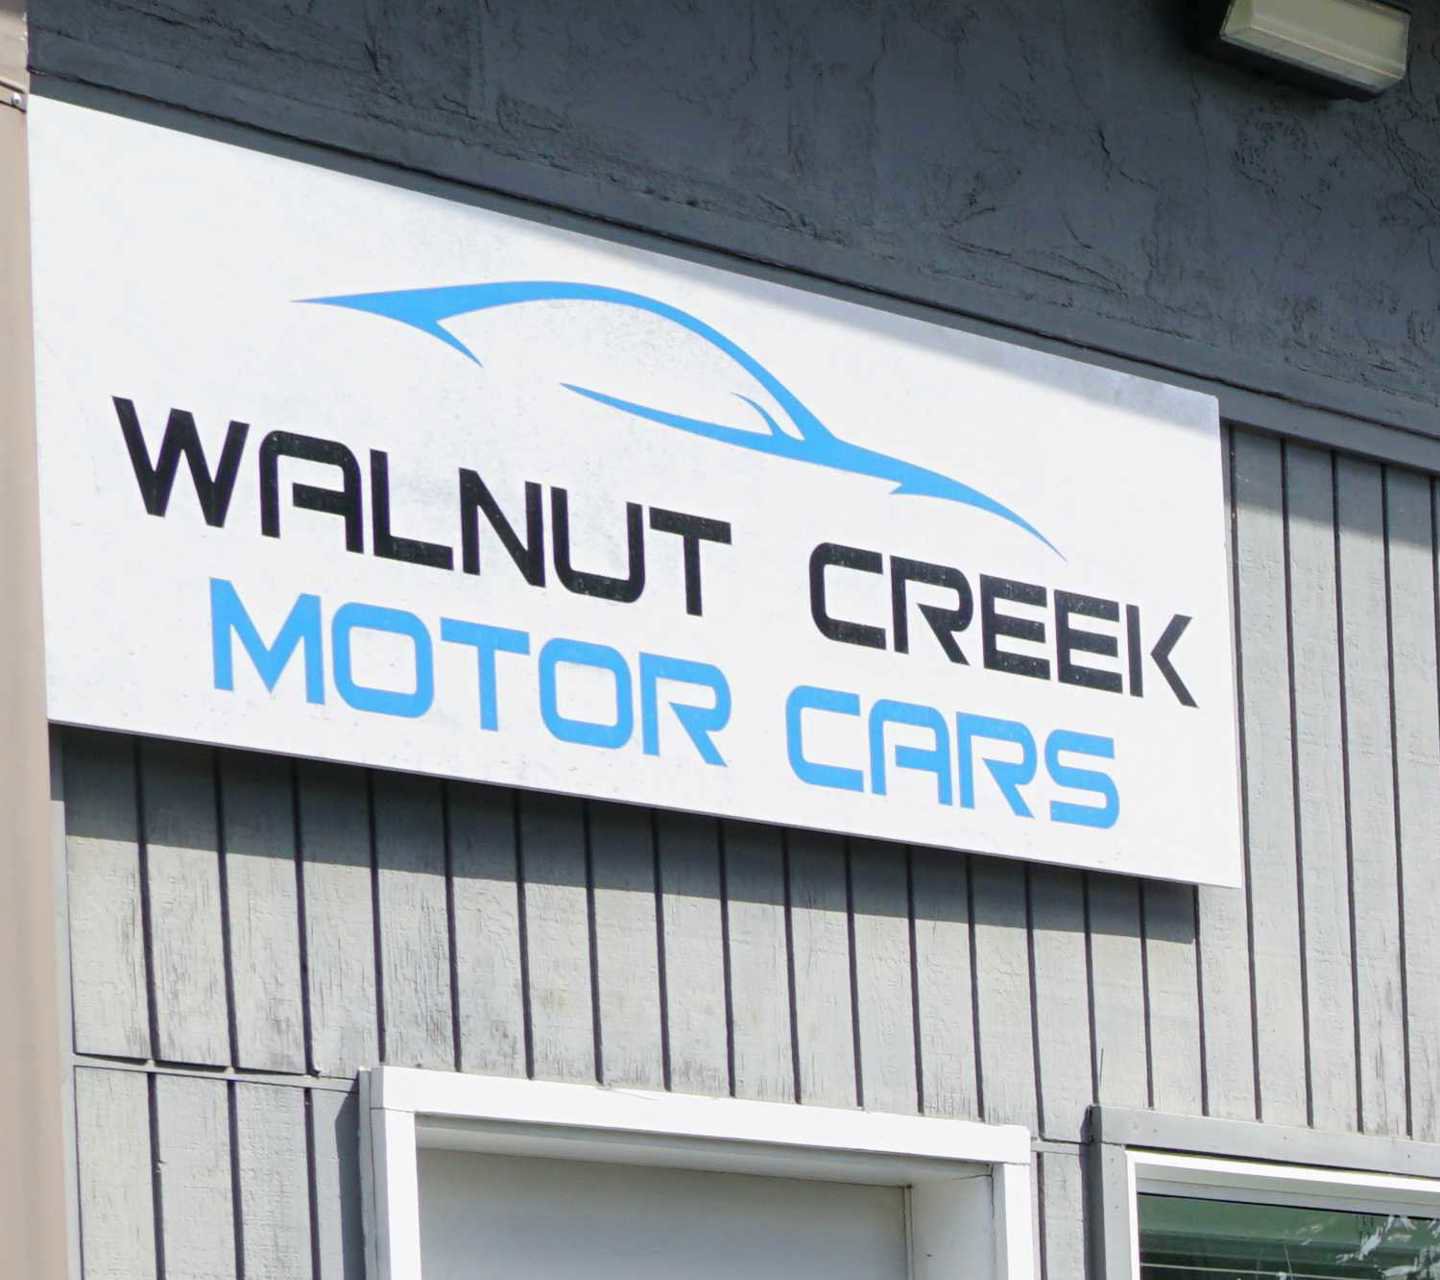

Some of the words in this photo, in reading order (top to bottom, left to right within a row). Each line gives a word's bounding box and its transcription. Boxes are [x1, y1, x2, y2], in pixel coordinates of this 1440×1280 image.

[112, 396, 731, 616] WALNUT
[809, 542, 1197, 708] CREEK
[210, 577, 731, 766] MOTOR
[786, 685, 1120, 829] CARS
